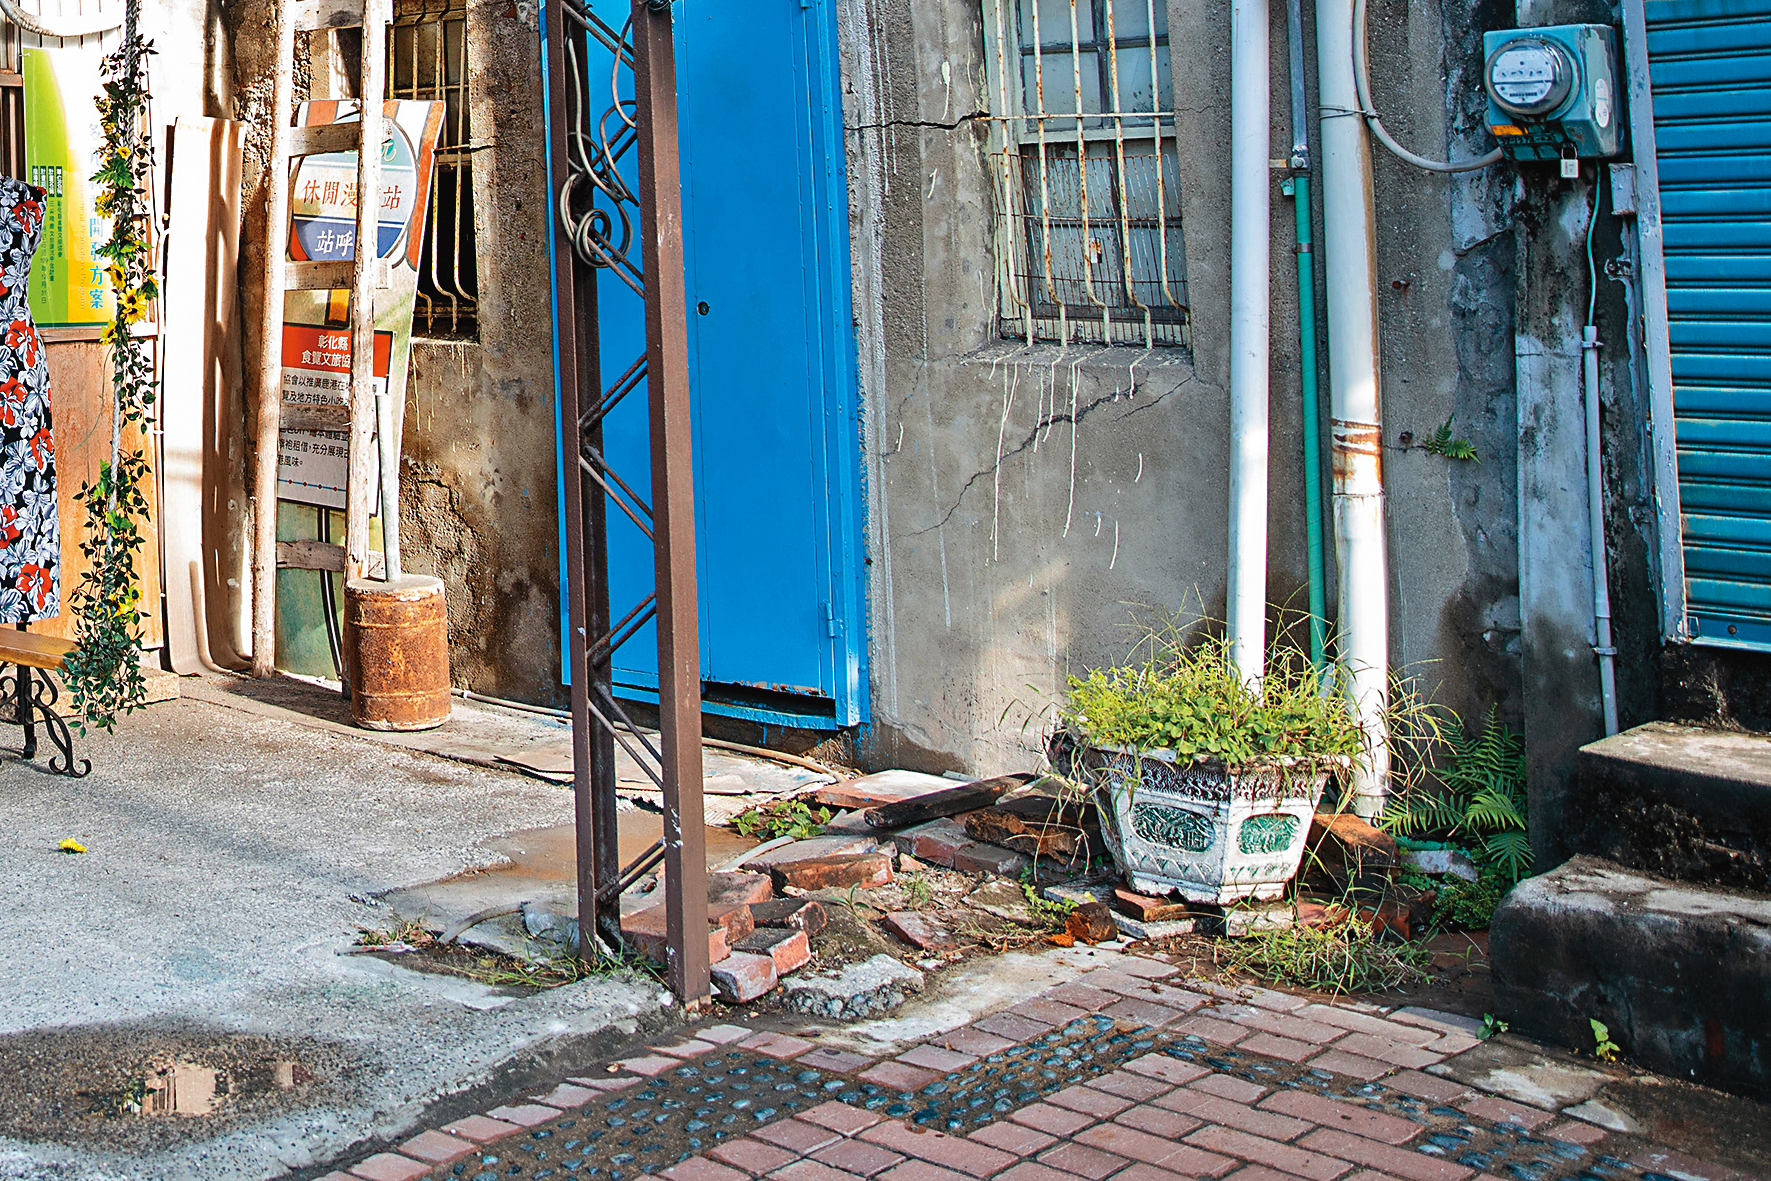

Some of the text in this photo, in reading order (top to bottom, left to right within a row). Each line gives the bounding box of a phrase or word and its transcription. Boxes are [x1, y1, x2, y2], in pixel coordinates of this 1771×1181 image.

[301, 179, 402, 210] 休閒漫站
[315, 229, 354, 257] 站呼
[318, 334, 348, 351] 彰化縣
